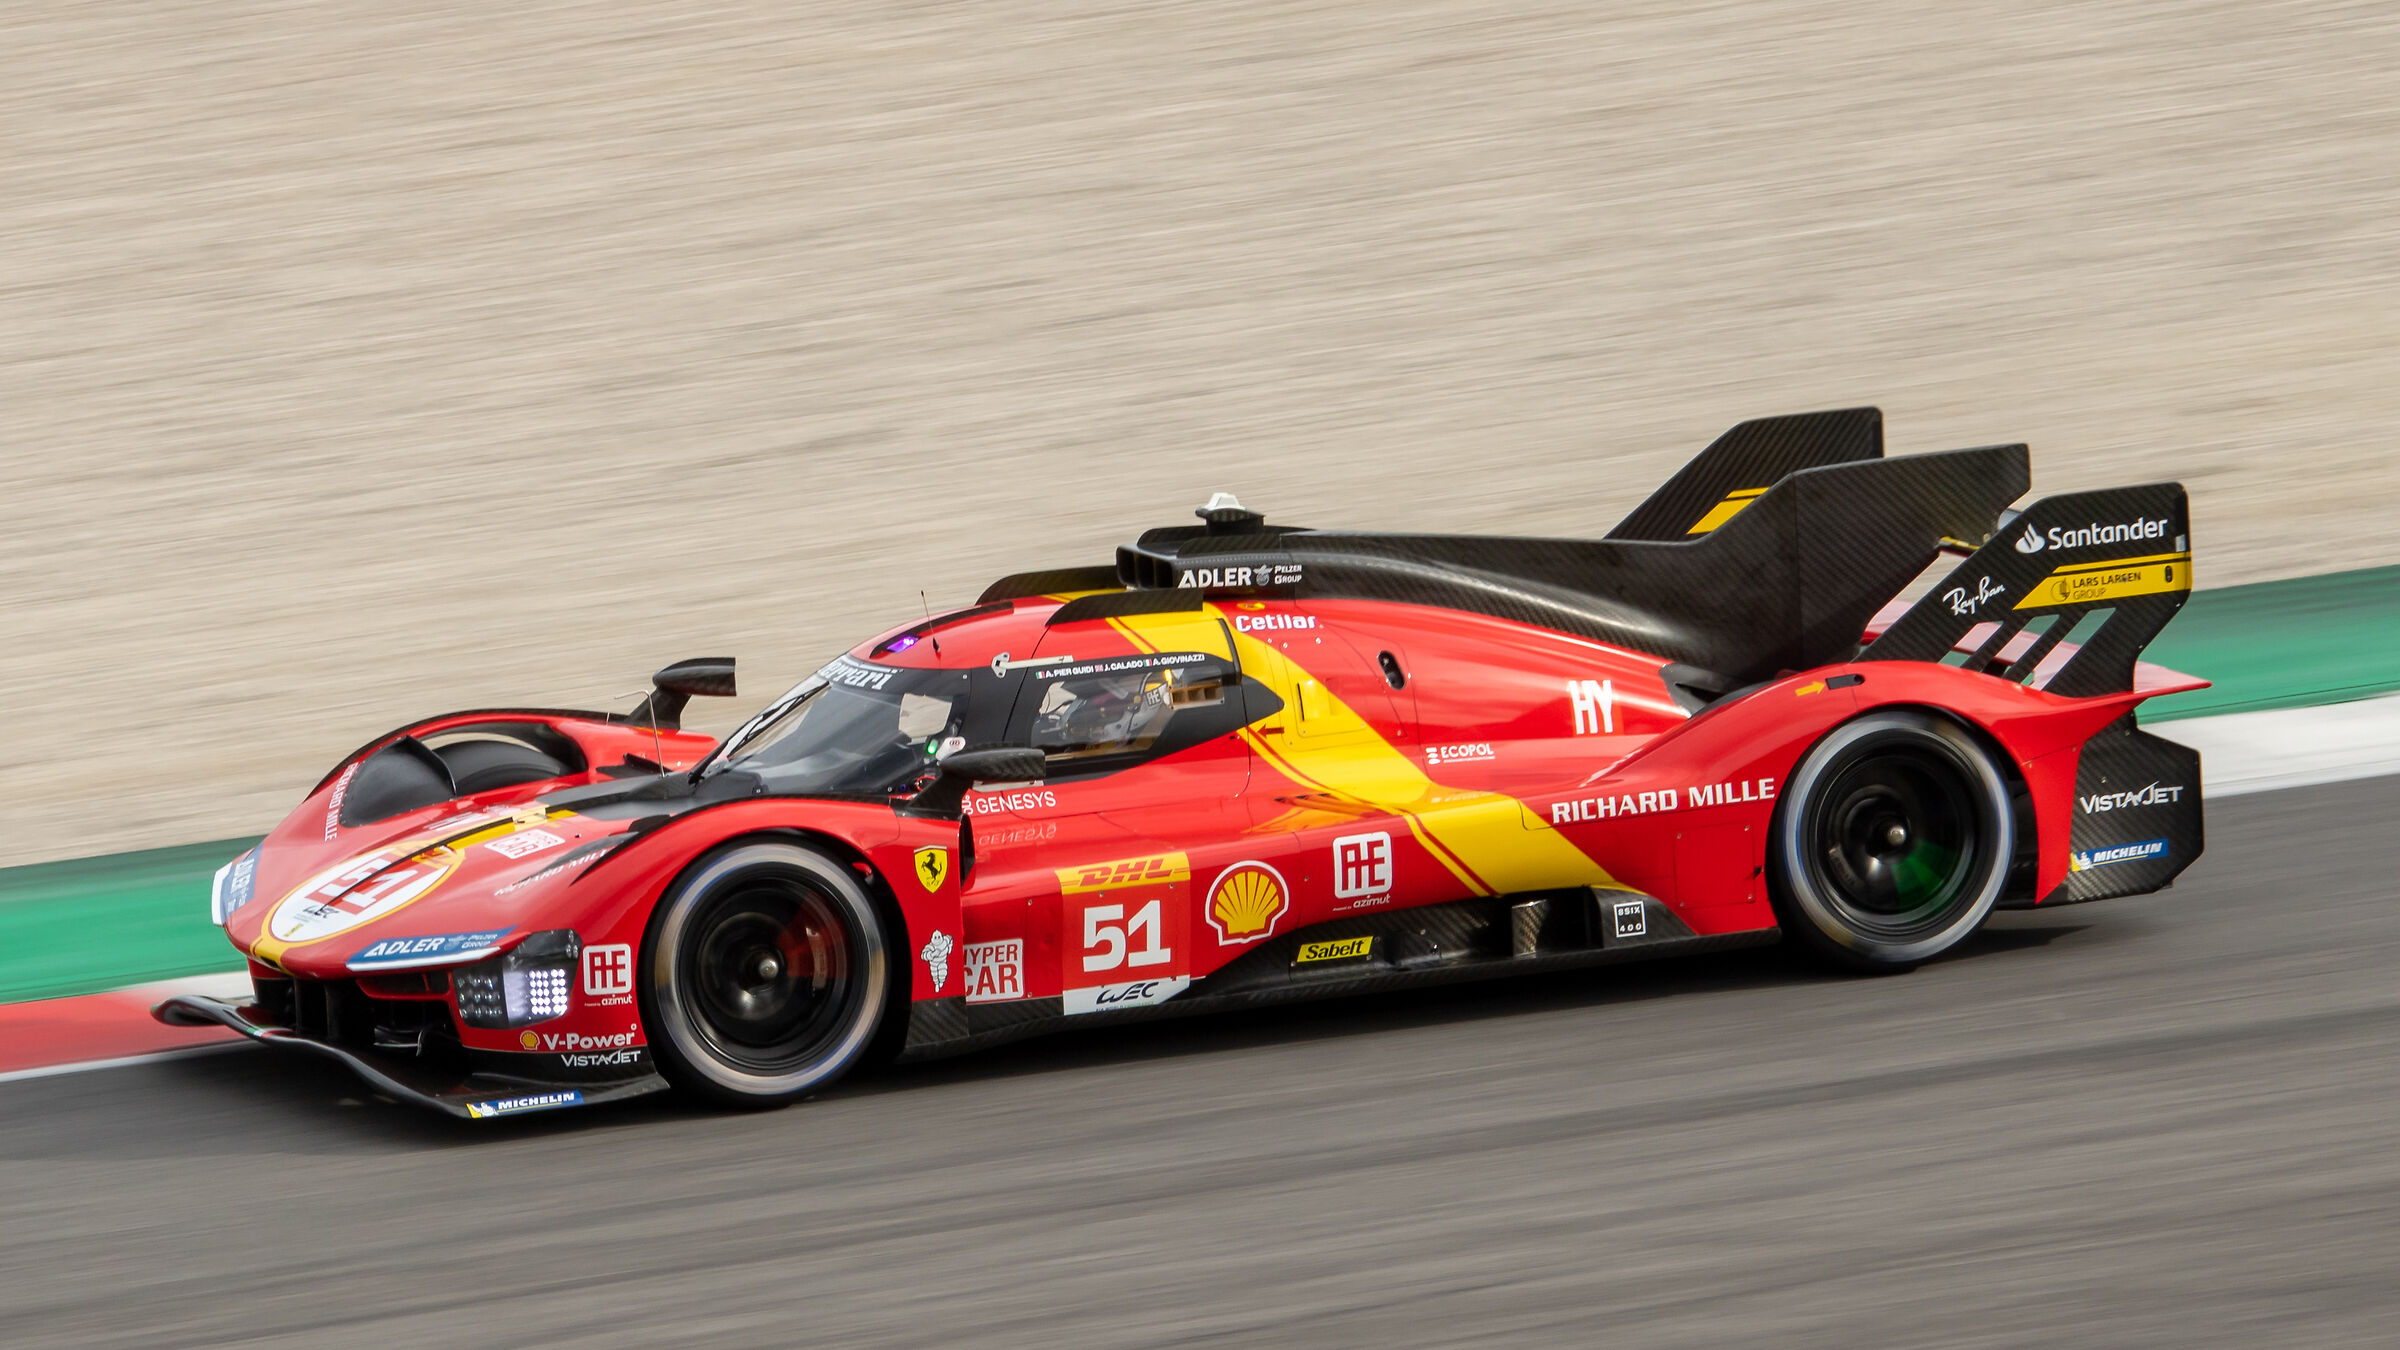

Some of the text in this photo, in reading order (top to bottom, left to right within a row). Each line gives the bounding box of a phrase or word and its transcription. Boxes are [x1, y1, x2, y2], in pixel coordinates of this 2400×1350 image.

[2048, 517, 2168, 550] Santander
[1177, 566, 1252, 589] ADLER
[1274, 564, 1302, 574] PELZER
[1274, 574, 1302, 585] GROUP
[2073, 575, 2099, 588] LARS
[1942, 575, 2006, 616] Ray-Ban
[2073, 586, 2106, 600] GROUP
[1235, 613, 1316, 633] Cetilar
[1111, 660, 1143, 671] CALADO
[1161, 653, 1205, 666] GIOVINAZZI
[1054, 667, 1072, 677] PIER
[1072, 665, 1094, 675] GUIDI
[1567, 680, 1613, 735] HY
[1440, 743, 1494, 759] ECOPOL
[976, 790, 1057, 815] GENESYS
[1551, 777, 1775, 824] RICHARD MILLE
[2080, 781, 2184, 814] VISTAJET
[2093, 842, 2163, 863] MICHELIN
[1078, 858, 1173, 887] DHL
[1353, 893, 1391, 908] azimut
[1082, 899, 1171, 973] 51
[364, 937, 446, 958] ADLER
[1305, 940, 1364, 960] Sabelt
[601, 994, 633, 1006] azimut
[1096, 981, 1159, 1005] WEC
[543, 1031, 635, 1051] V-Power
[560, 1047, 641, 1068] VISTAJET
[498, 1092, 575, 1111] MICHELIN
